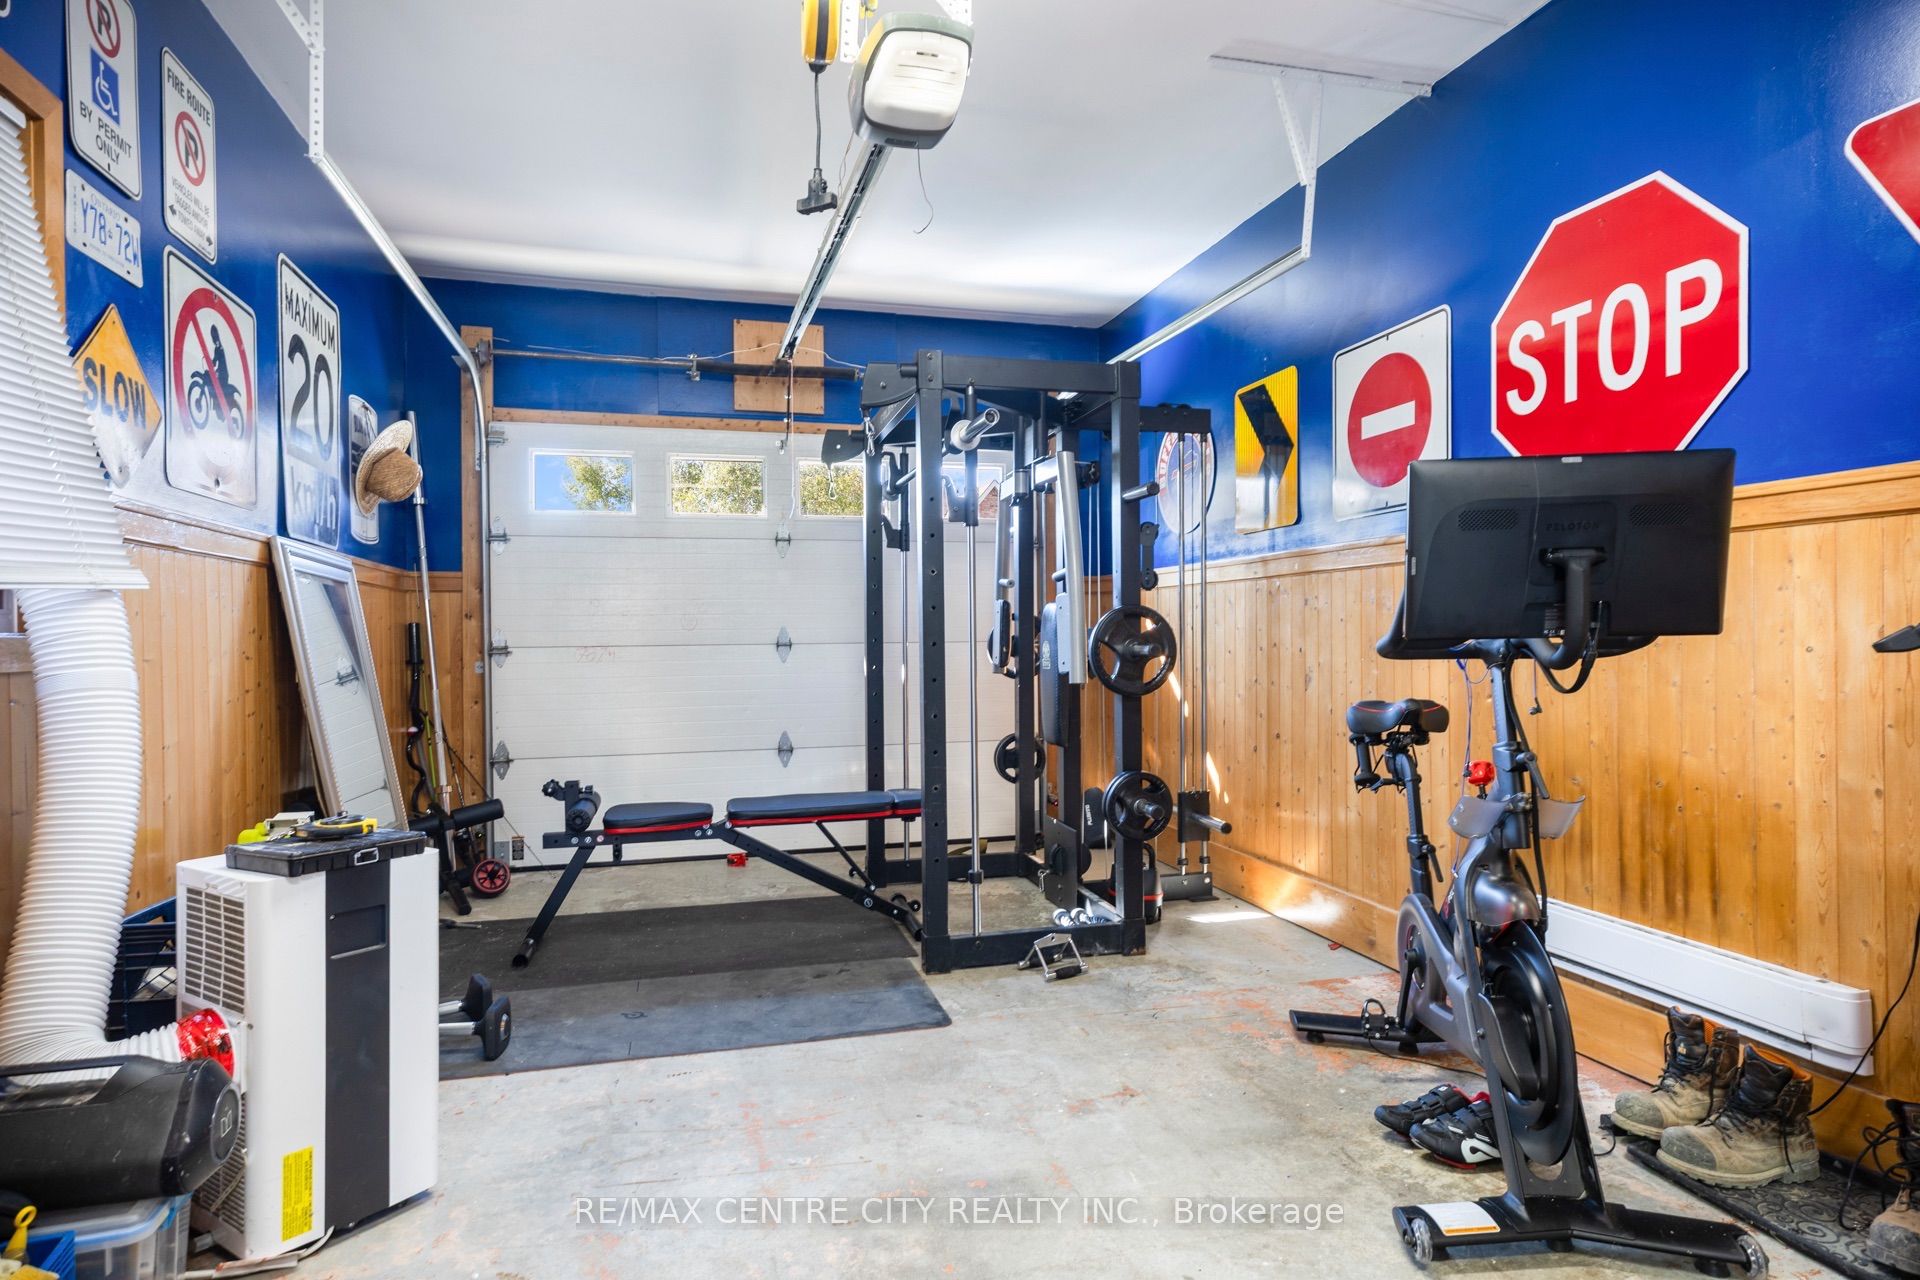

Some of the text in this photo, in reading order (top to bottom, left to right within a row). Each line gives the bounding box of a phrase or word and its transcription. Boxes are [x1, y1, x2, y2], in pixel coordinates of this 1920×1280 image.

[80, 101, 132, 158] BY PERMIT
[167, 67, 211, 127] FIRE ROUTE
[95, 134, 120, 165] ONLY
[285, 282, 335, 354] MAXIMUM
[1506, 258, 1723, 416] STOP
[82, 357, 146, 430] SLOW
[287, 333, 334, 461] 20
